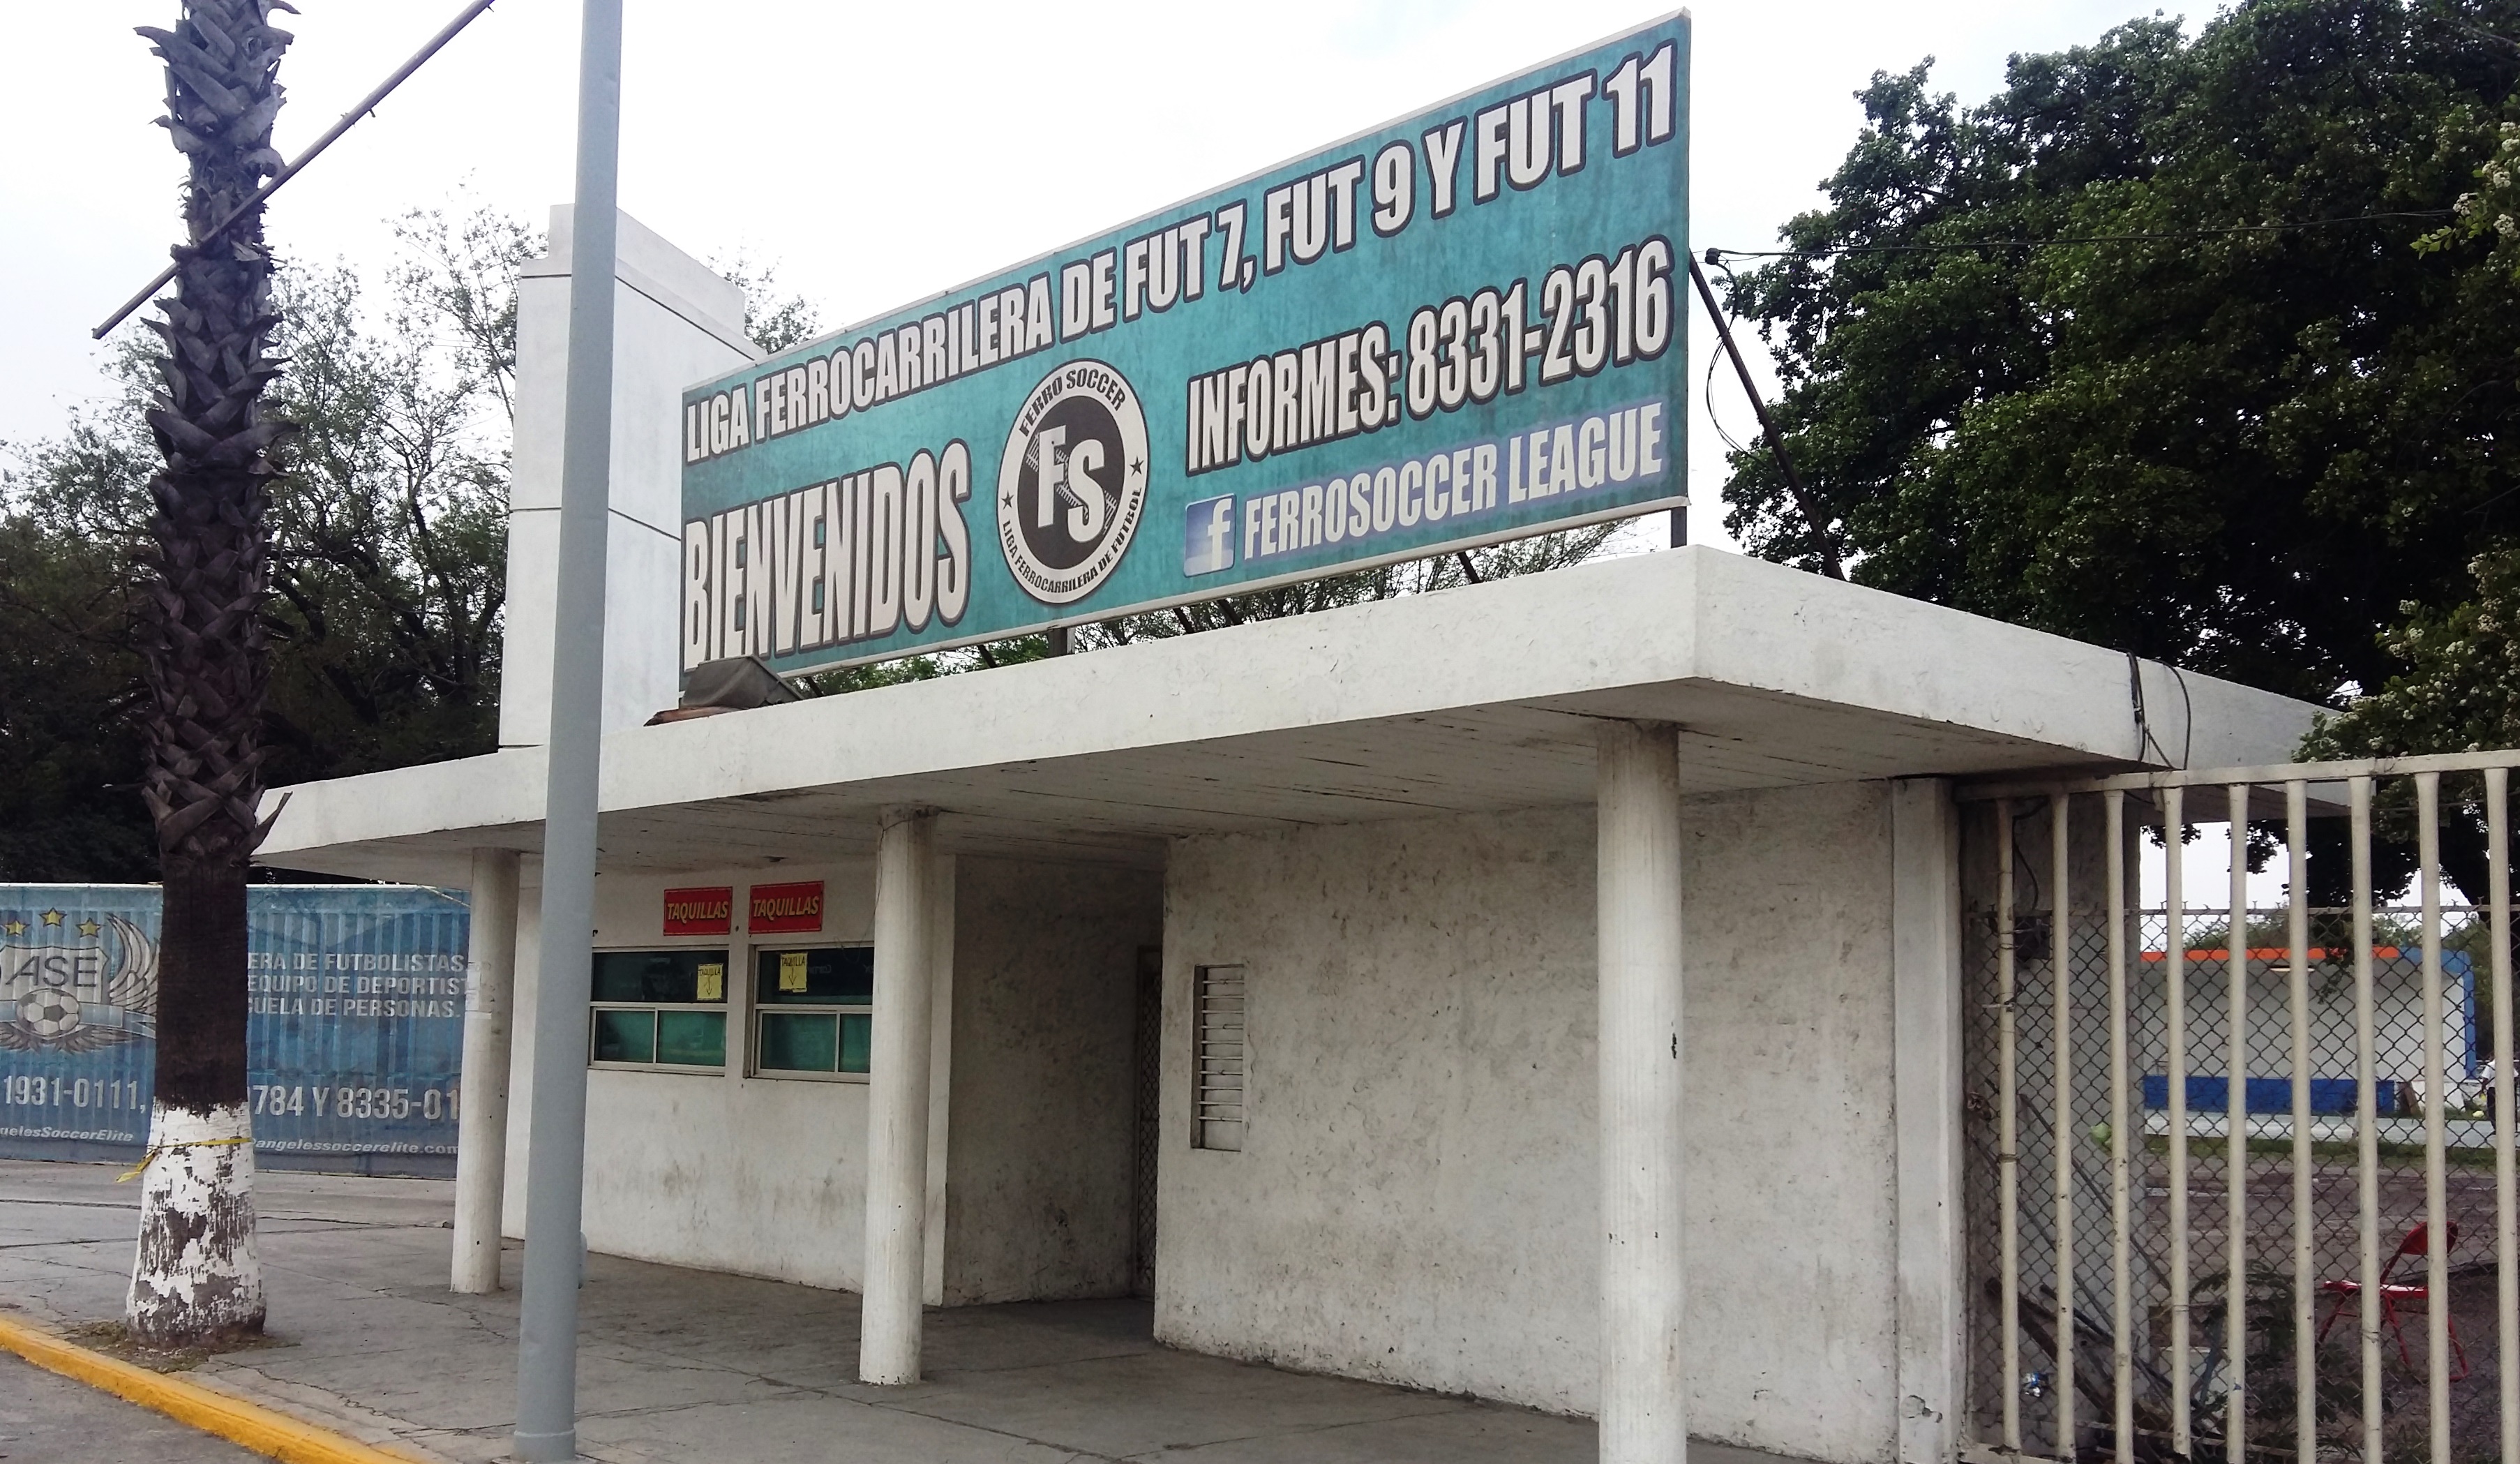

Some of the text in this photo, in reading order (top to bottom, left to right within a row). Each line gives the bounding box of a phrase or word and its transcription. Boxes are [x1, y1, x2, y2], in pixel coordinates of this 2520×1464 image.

[687, 43, 1674, 464] LIGA FERROCARRILERA DE FUT 7, FUT 9 Y FUT 11
[1188, 239, 1670, 473] INFORMES: 8331-2316
[1019, 367, 1127, 438] FERRO SOCCER
[1244, 401, 1663, 560] FERROSOCCER LEAGUE
[1002, 486, 1142, 593] LIGA FERROCARRILERA DE FUTBOL
[683, 440, 972, 673] BIENVENIDOS
[667, 902, 729, 925] TAQUILLAS
[753, 895, 820, 922] TAQUILLAS
[5, 955, 98, 987] ASE
[294, 953, 318, 970] DE
[698, 966, 721, 976] TAQUILLA
[781, 957, 806, 967] TAQUILLA
[248, 975, 317, 993] EQUIPO
[324, 976, 350, 994] DE
[311, 998, 337, 1016] DE
[343, 999, 460, 1018] PERSONAS.
[3, 1075, 458, 1120] 1931-0111, 784 Y 8335-01
